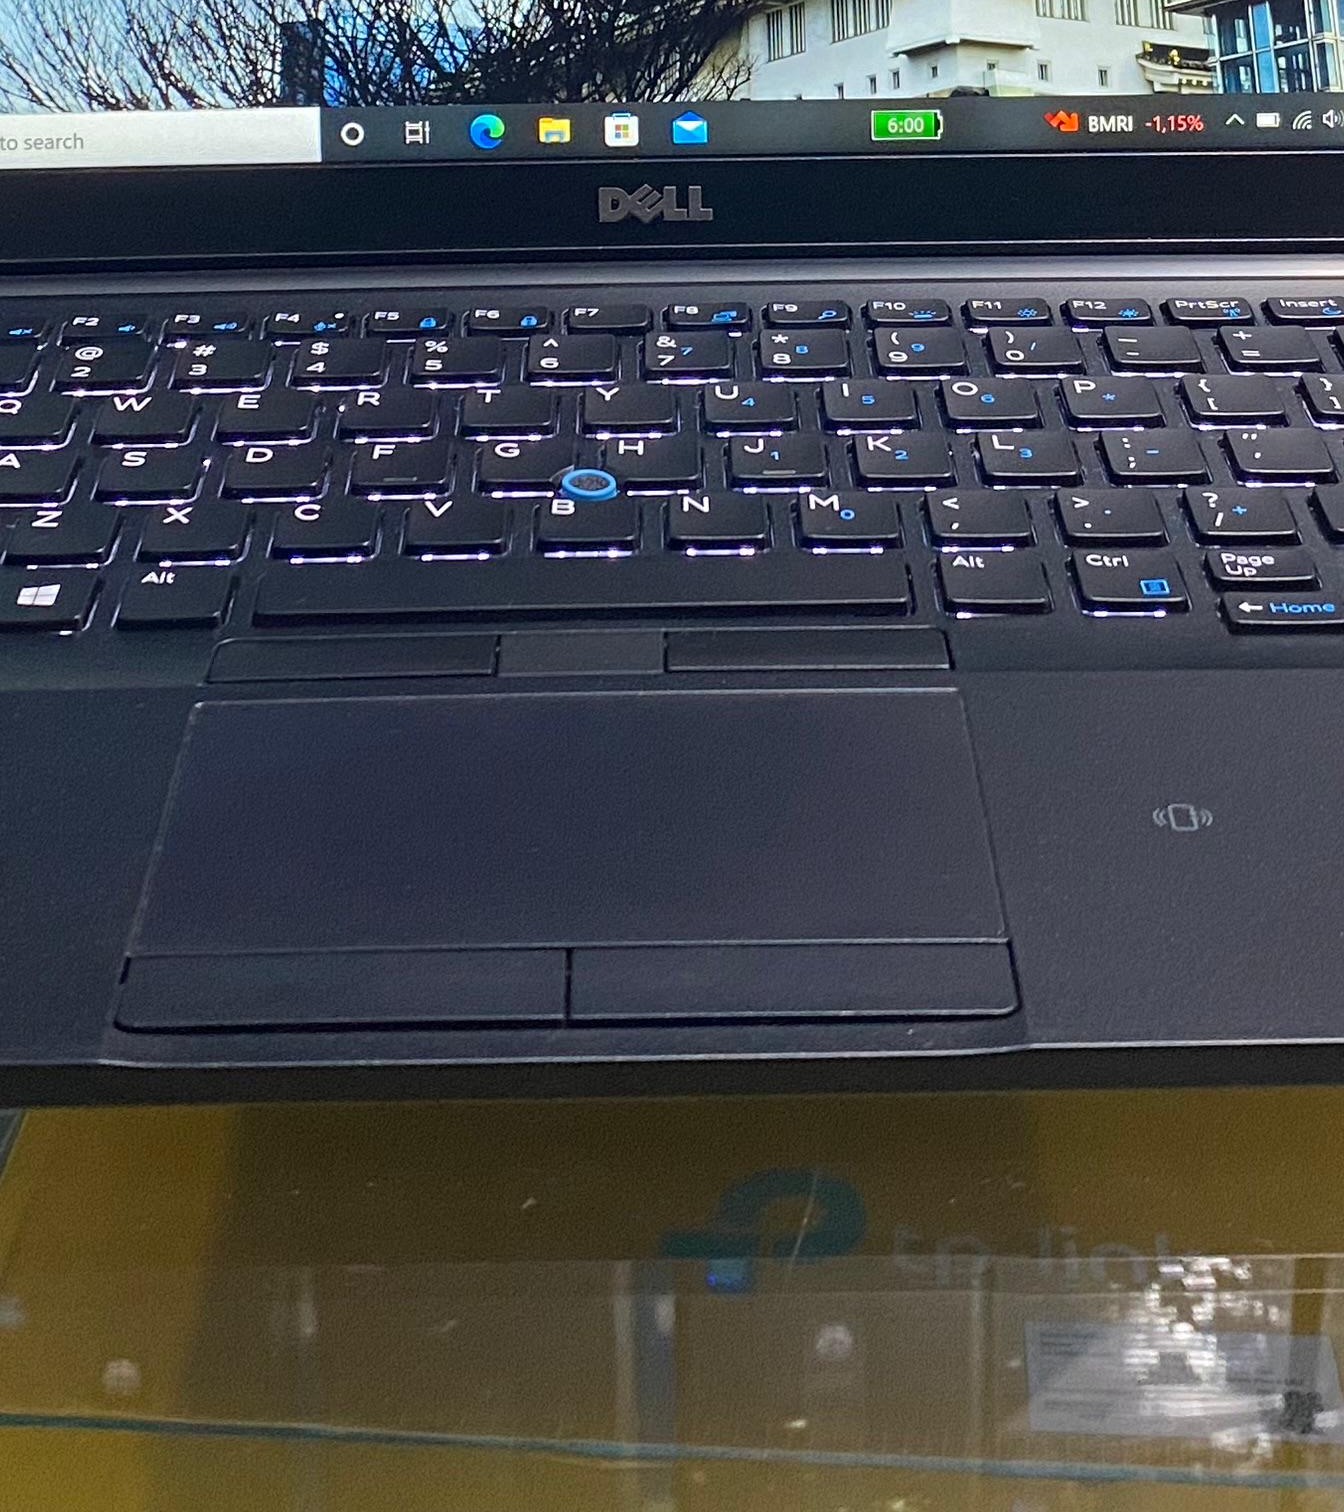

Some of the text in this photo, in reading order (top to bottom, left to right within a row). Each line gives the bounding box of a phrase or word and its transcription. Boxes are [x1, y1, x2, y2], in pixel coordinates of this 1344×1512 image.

[886, 115, 926, 135] 6:00
[1087, 112, 1205, 135] BMRI -1,15%
[0, 135, 19, 152] to
[23, 132, 85, 152] search
[597, 183, 715, 225] DELL
[673, 306, 699, 315] F8
[772, 304, 798, 313] F9
[872, 301, 906, 311] F10
[971, 300, 1002, 310] F11
[1072, 299, 1106, 310] F12
[1174, 298, 1239, 310] PrtScr
[1279, 298, 1338, 309] Insert
[174, 314, 201, 325] F3
[274, 313, 300, 323] F4
[374, 311, 400, 321] F5
[474, 309, 500, 319] F6
[574, 307, 599, 317] F7
[72, 316, 99, 327] F2
[424, 358, 442, 370] 5
[540, 356, 559, 368] 6
[657, 355, 674, 367] 7
[772, 353, 791, 365] 8
[888, 350, 908, 363] 9
[71, 365, 92, 378] 2
[188, 363, 207, 376] 3
[306, 361, 326, 373] 4
[595, 387, 620, 402] Y
[714, 384, 739, 400] U
[952, 381, 979, 396] O
[1073, 380, 1097, 394] P
[237, 394, 261, 410] E
[357, 391, 381, 406] R
[477, 388, 502, 404] T
[112, 396, 152, 412] W
[494, 442, 520, 457] G
[618, 440, 646, 455] H
[744, 438, 765, 454] J
[867, 436, 892, 452] K
[992, 435, 1015, 451] L
[123, 451, 148, 467] S
[245, 448, 273, 463] D
[372, 445, 397, 460] F
[424, 501, 453, 517] V
[551, 499, 576, 516] B
[682, 496, 710, 513] N
[808, 494, 840, 512] M
[32, 511, 62, 527] Z
[162, 508, 193, 525] X
[294, 504, 322, 522] C
[953, 554, 986, 569] Alt
[1086, 554, 1129, 568] Ctrl
[1221, 553, 1275, 569] Page
[141, 571, 176, 585] Alt
[1224, 565, 1257, 578] Up
[1268, 601, 1336, 615] Home
